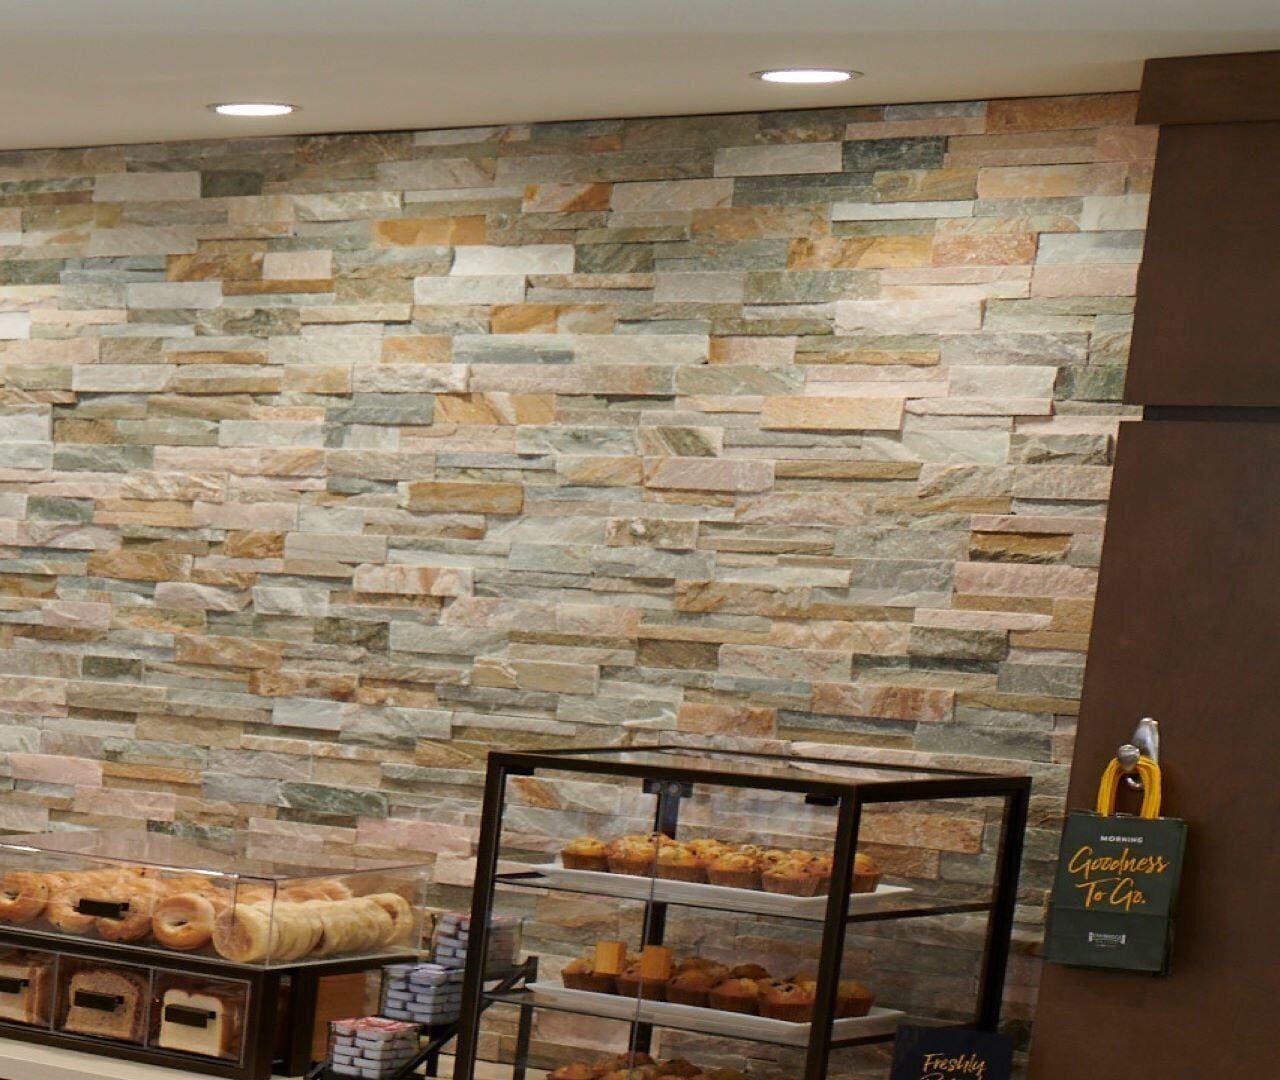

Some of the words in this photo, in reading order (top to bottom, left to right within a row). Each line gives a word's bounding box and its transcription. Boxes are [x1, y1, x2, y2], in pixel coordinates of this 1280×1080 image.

[1100, 835, 1144, 843] MORNING
[1067, 845, 1171, 881] Goodness
[1074, 877, 1121, 909] To
[1109, 877, 1147, 912] Go.
[923, 1053, 986, 1077] Freshly
